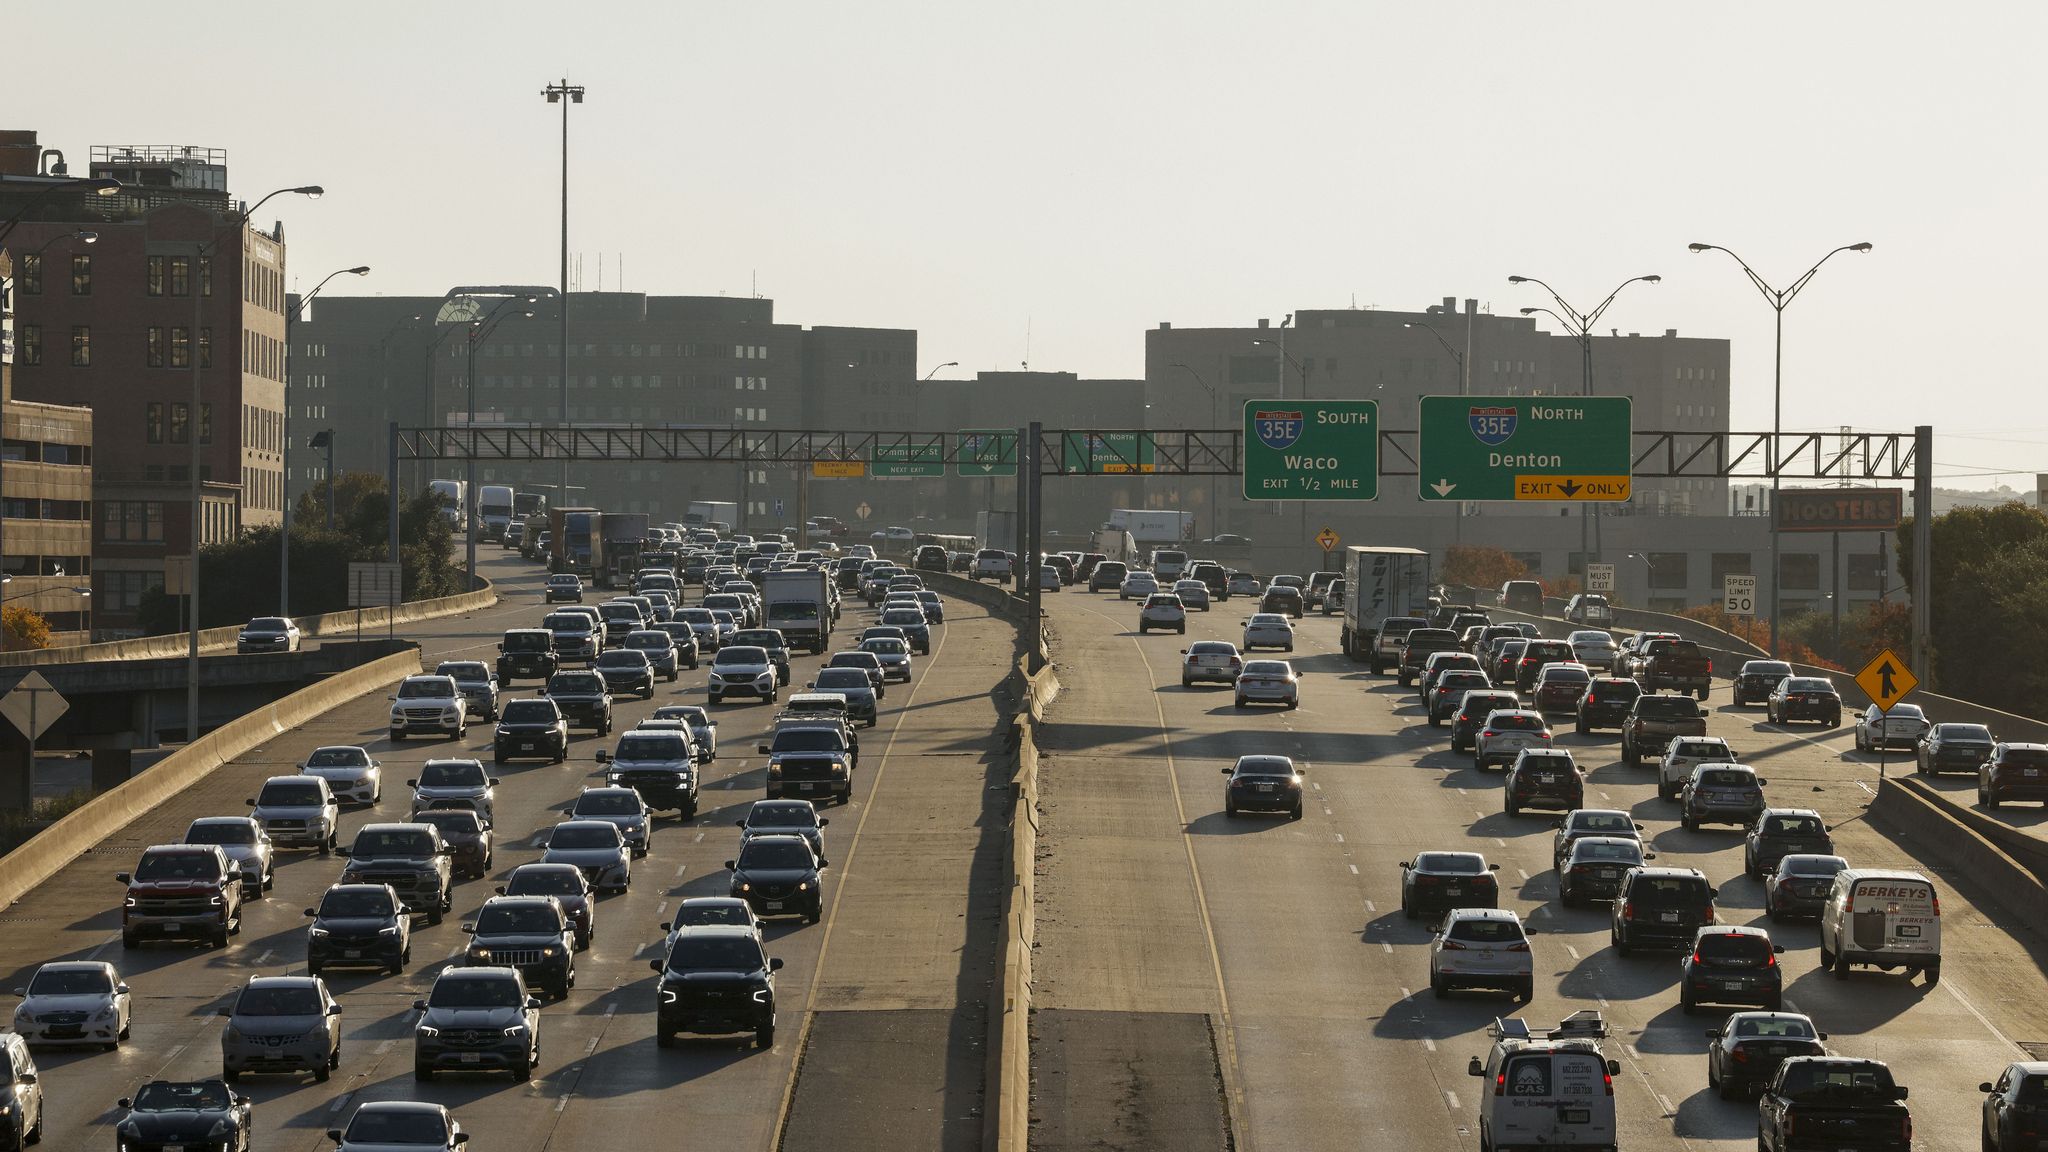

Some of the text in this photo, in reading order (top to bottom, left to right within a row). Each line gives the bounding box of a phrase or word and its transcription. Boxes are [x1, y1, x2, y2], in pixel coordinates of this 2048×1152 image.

[1317, 410, 1368, 424] SOUTH
[1531, 406, 1583, 420] NORTH
[1263, 421, 1295, 439] 35E
[1477, 417, 1509, 435] 35E
[929, 448, 939, 456] St
[1284, 455, 1338, 470] Waco
[1489, 453, 1561, 467] Denton
[1263, 477, 1359, 490] EXIT 1/2 MILE
[1521, 483, 1626, 495] EXIT ONLY
[1782, 499, 1892, 520] HOOTERS
[1372, 556, 1387, 609] SWIFT
[1590, 572, 1611, 580] MUST
[1727, 578, 1755, 586] SPEED
[1592, 581, 1609, 589] EXIT
[1729, 588, 1750, 596] LIMIT
[1728, 598, 1751, 611] 50
[1857, 886, 1928, 899] BERKEYS
[1514, 1085, 1545, 1094] CAS
